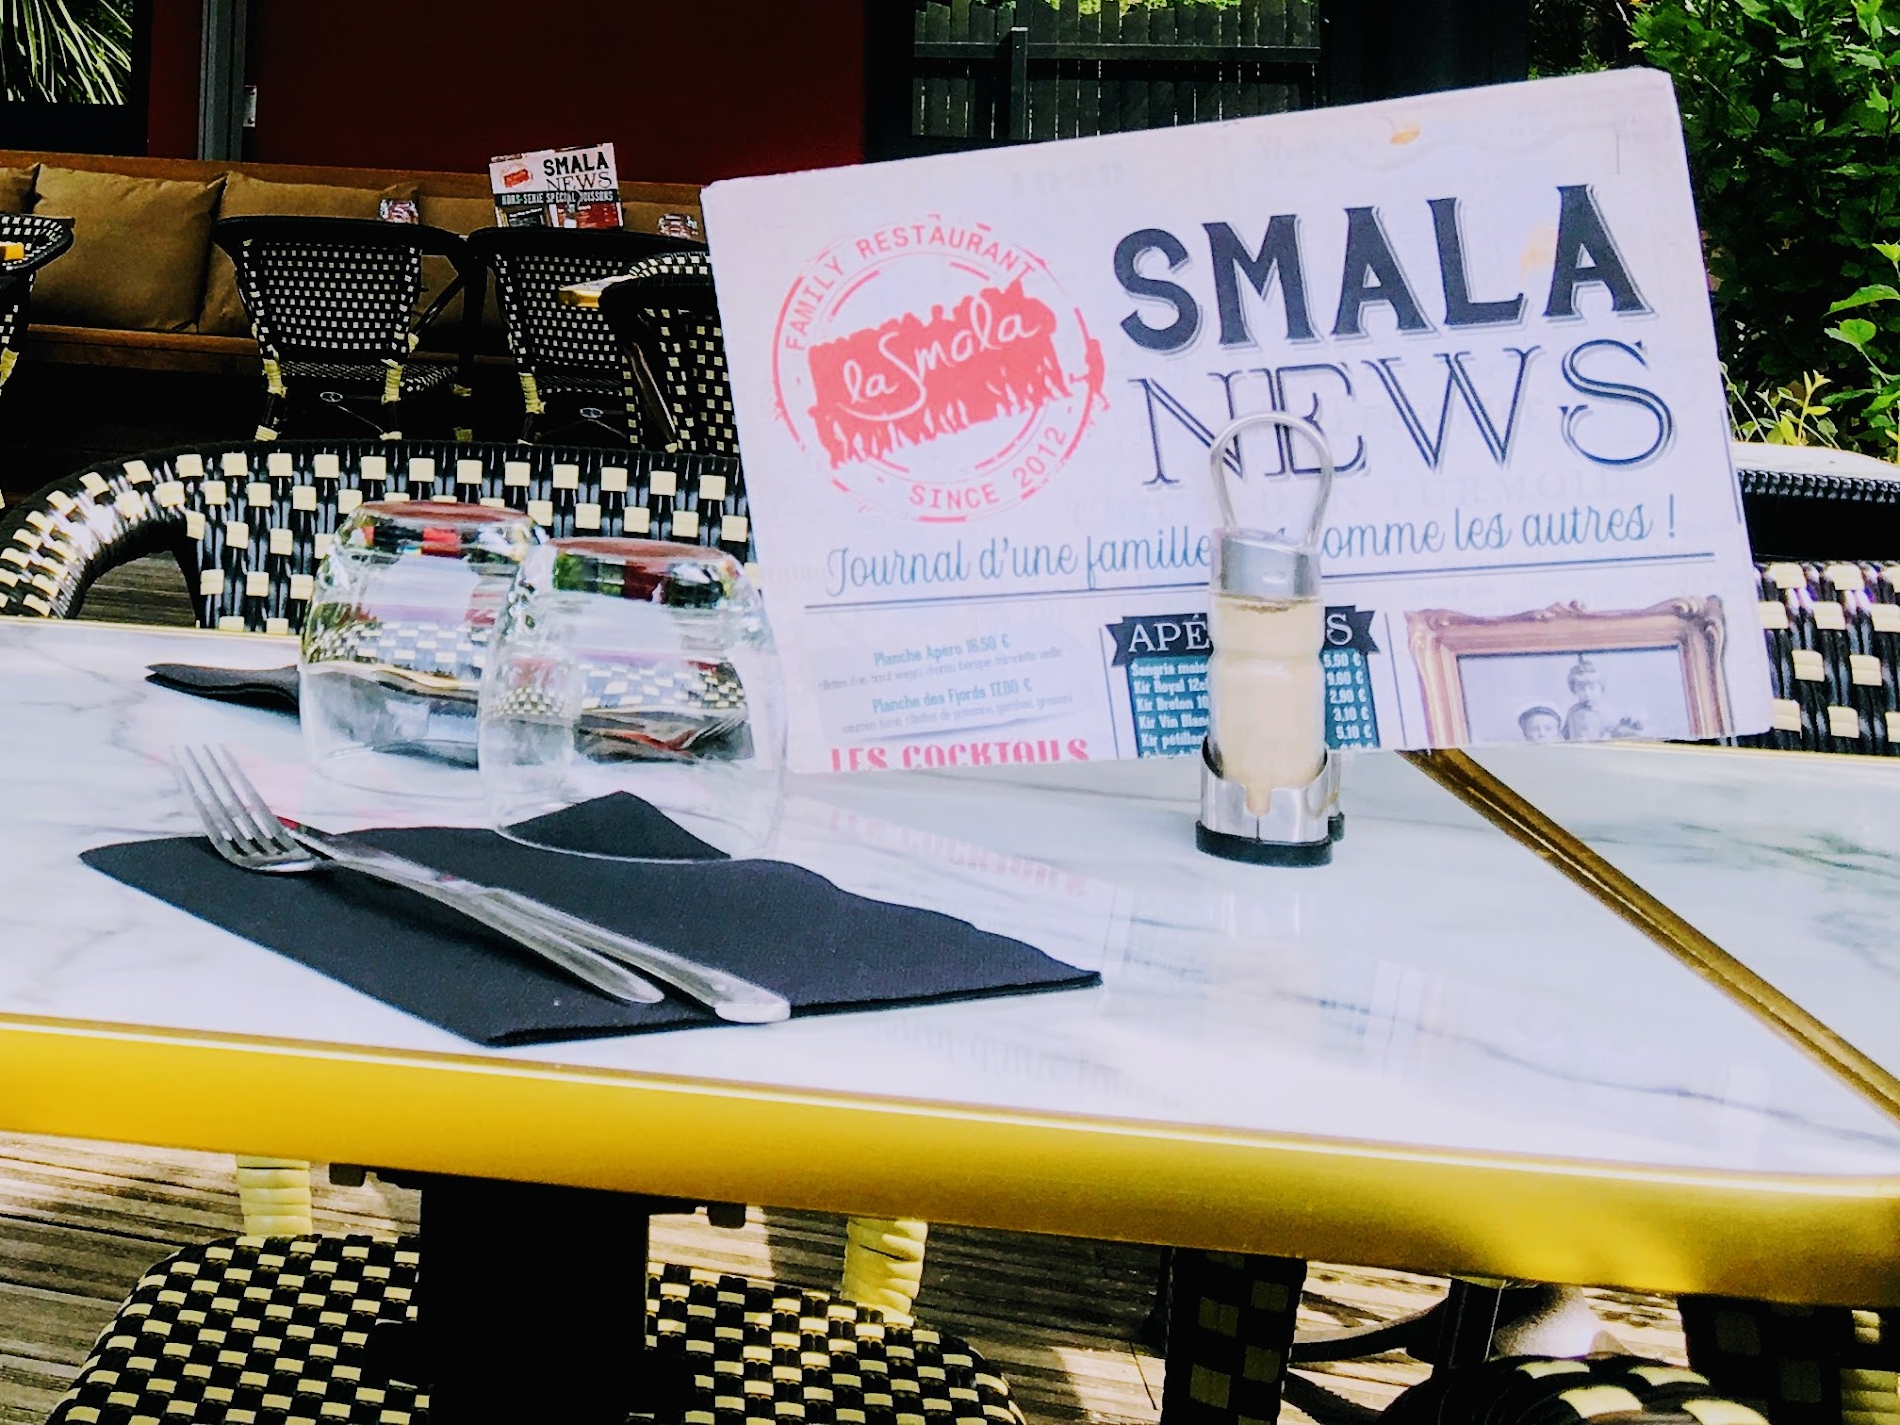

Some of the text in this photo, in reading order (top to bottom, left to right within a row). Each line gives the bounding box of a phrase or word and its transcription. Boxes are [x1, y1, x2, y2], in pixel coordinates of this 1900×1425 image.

[543, 151, 609, 176] SMALA
[546, 171, 612, 191] NEWS
[1113, 183, 1657, 354] SMALA
[785, 223, 1037, 352] FAMILY RESTAURANT
[836, 297, 1040, 421] la Smala
[1128, 338, 1675, 487] NEWS
[909, 425, 1068, 510] SINCE 2012
[826, 493, 1677, 596] Journal d'une famille omme les autres !
[873, 647, 922, 667] Planche
[1001, 633, 1010, 648] €
[1131, 659, 1174, 680] Sangria
[1353, 651, 1362, 667] €
[872, 694, 921, 714] Planche
[924, 691, 946, 706] des
[949, 685, 987, 704] Fjords
[1024, 677, 1033, 693] €
[1134, 679, 1150, 694] Kir
[1154, 677, 1185, 696] Royal
[1355, 670, 1365, 685] €
[1136, 697, 1154, 712] Kir
[1156, 696, 1195, 711] Breton
[1358, 688, 1367, 703] €
[1139, 715, 1156, 730] Kir
[1159, 714, 1179, 729] Vin
[1361, 706, 1370, 721] €
[1141, 733, 1158, 747] Kir
[1363, 724, 1372, 739] €
